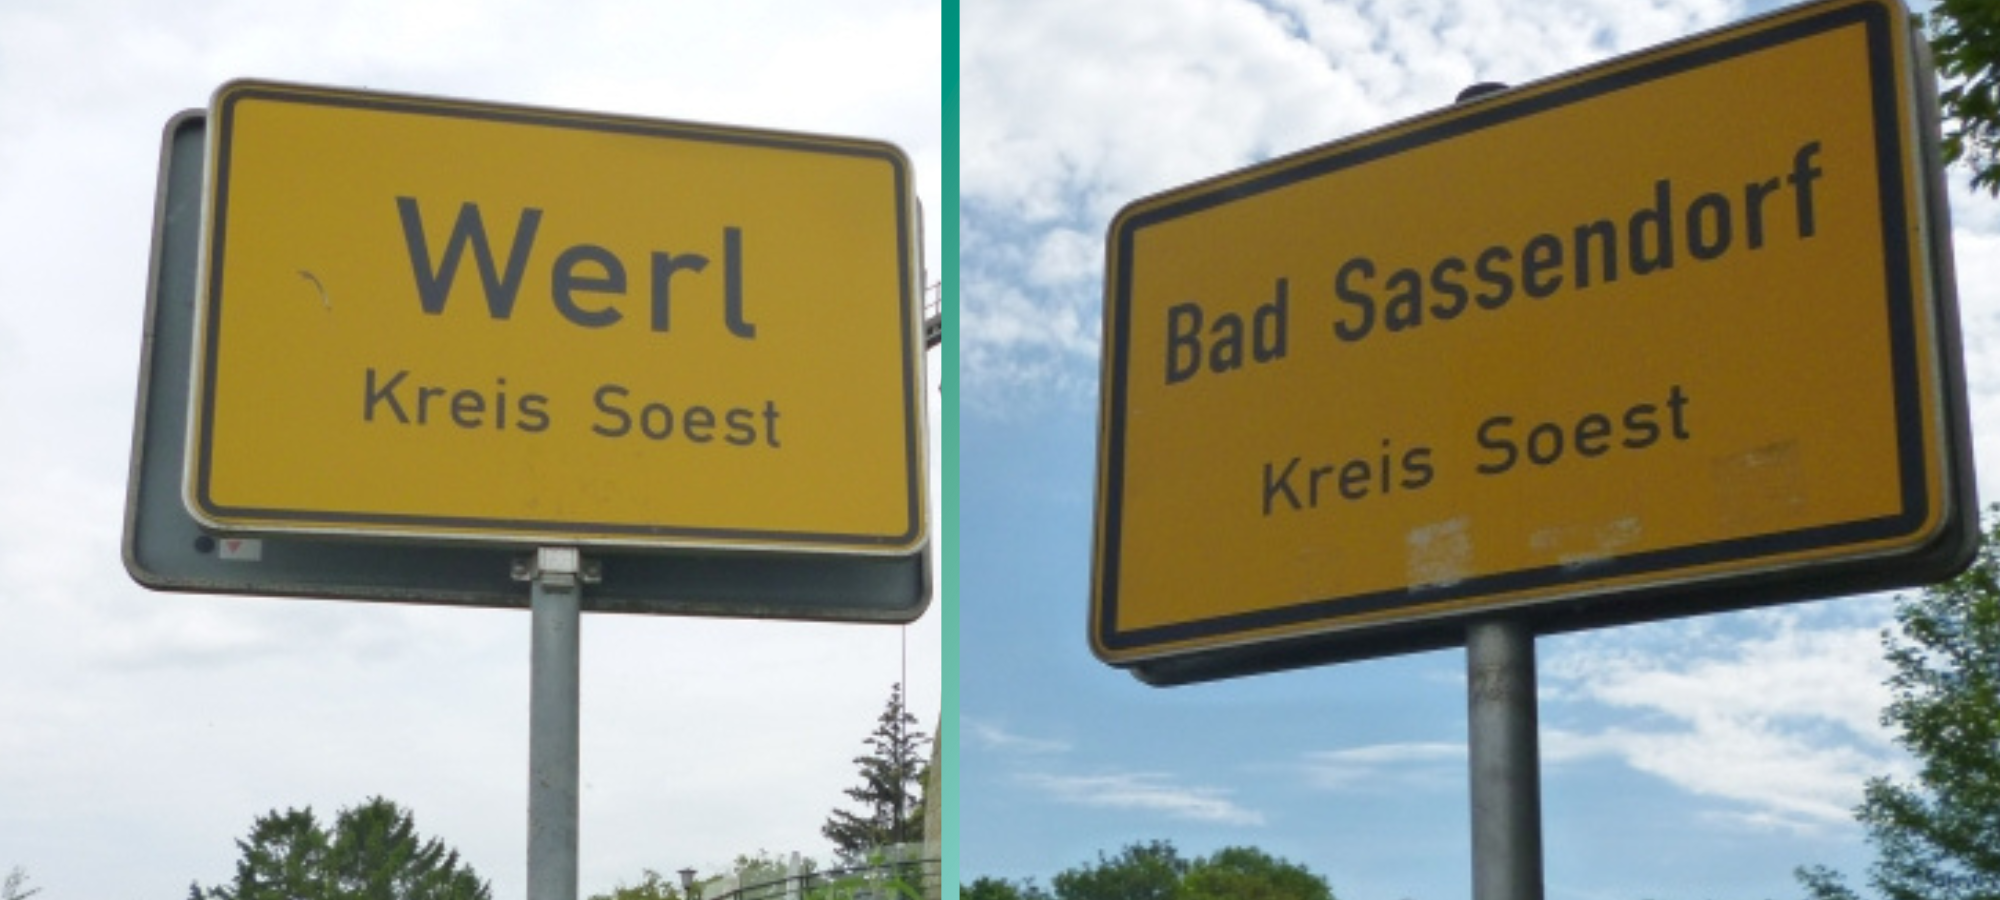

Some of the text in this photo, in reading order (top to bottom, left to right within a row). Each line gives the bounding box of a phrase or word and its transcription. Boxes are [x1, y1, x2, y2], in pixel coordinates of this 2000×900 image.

[395, 195, 757, 340] Werl
[1163, 140, 1824, 386] Bad Sassendorf
[363, 368, 781, 449] Kreis Soest
[1260, 384, 1691, 516] Kreis Soest
